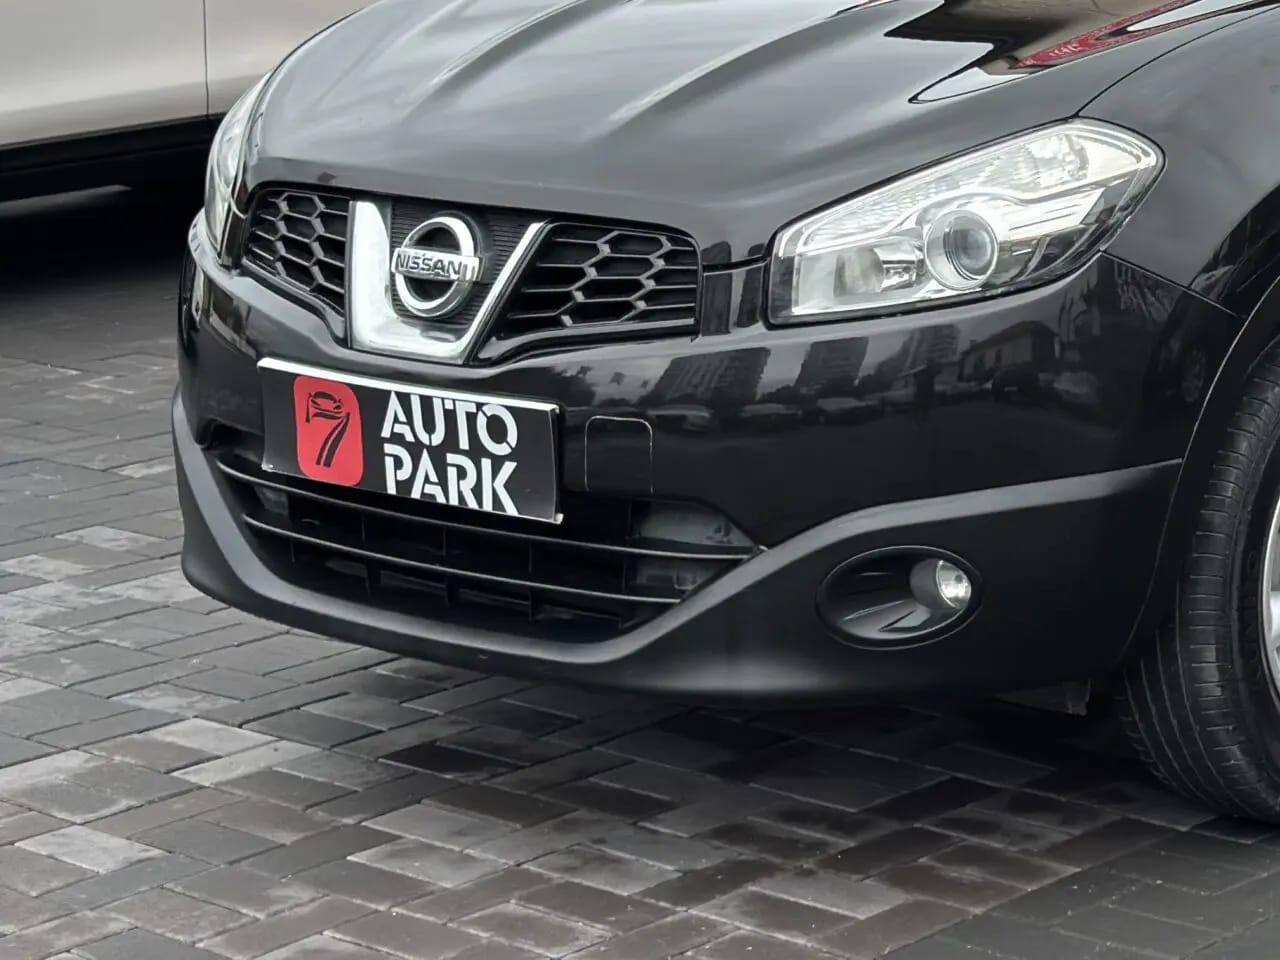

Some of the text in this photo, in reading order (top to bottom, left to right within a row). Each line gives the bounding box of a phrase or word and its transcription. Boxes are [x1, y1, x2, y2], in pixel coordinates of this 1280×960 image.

[397, 253, 462, 276] NISSAN
[381, 390, 518, 456] AUTO
[384, 443, 519, 515] PARK
